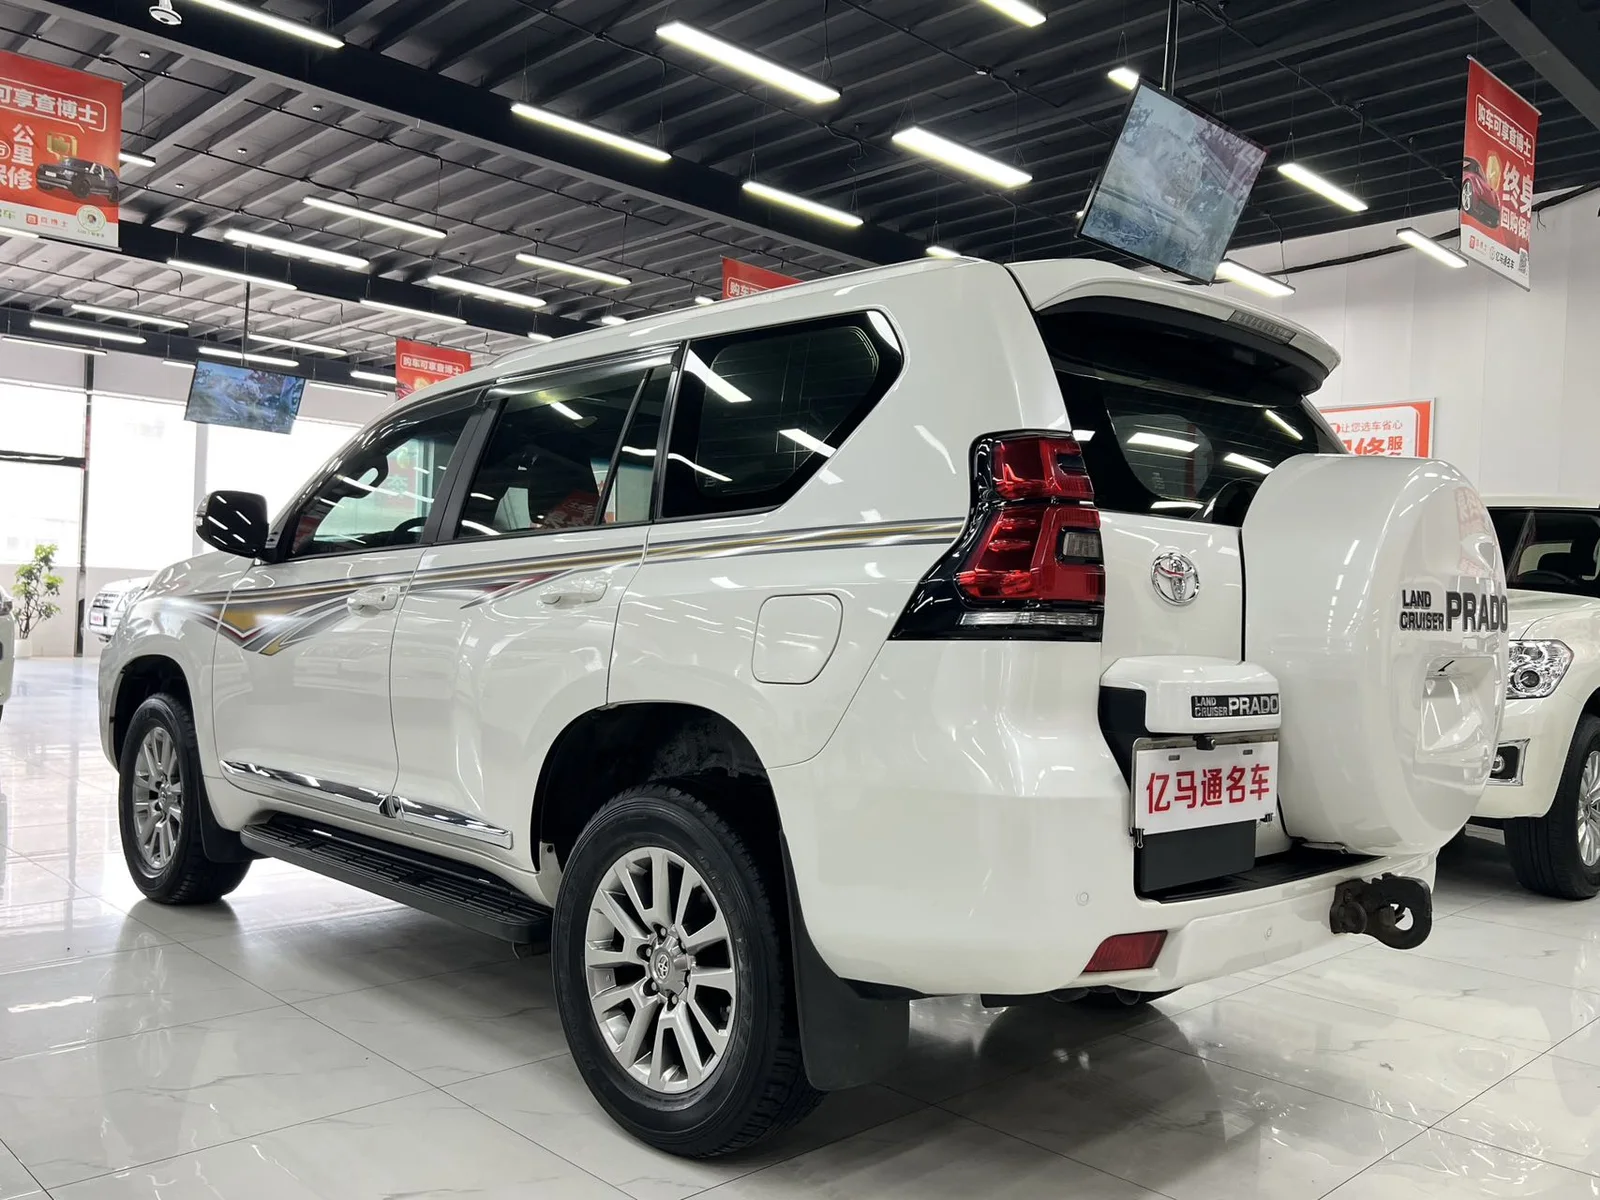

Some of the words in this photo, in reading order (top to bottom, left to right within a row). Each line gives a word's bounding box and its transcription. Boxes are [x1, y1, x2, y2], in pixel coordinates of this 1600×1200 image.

[1477, 102, 1531, 157] 购车可享查博士
[1341, 420, 1403, 434] 让您选车省心
[1402, 589, 1431, 609] LAND
[1400, 611, 1444, 631] CRUISER
[1446, 591, 1508, 633] PRADO
[1194, 696, 1217, 707] LAND
[1194, 706, 1228, 717] CRUISER
[1228, 695, 1278, 715] PRADO
[1146, 763, 1270, 814] 亿马通名车
